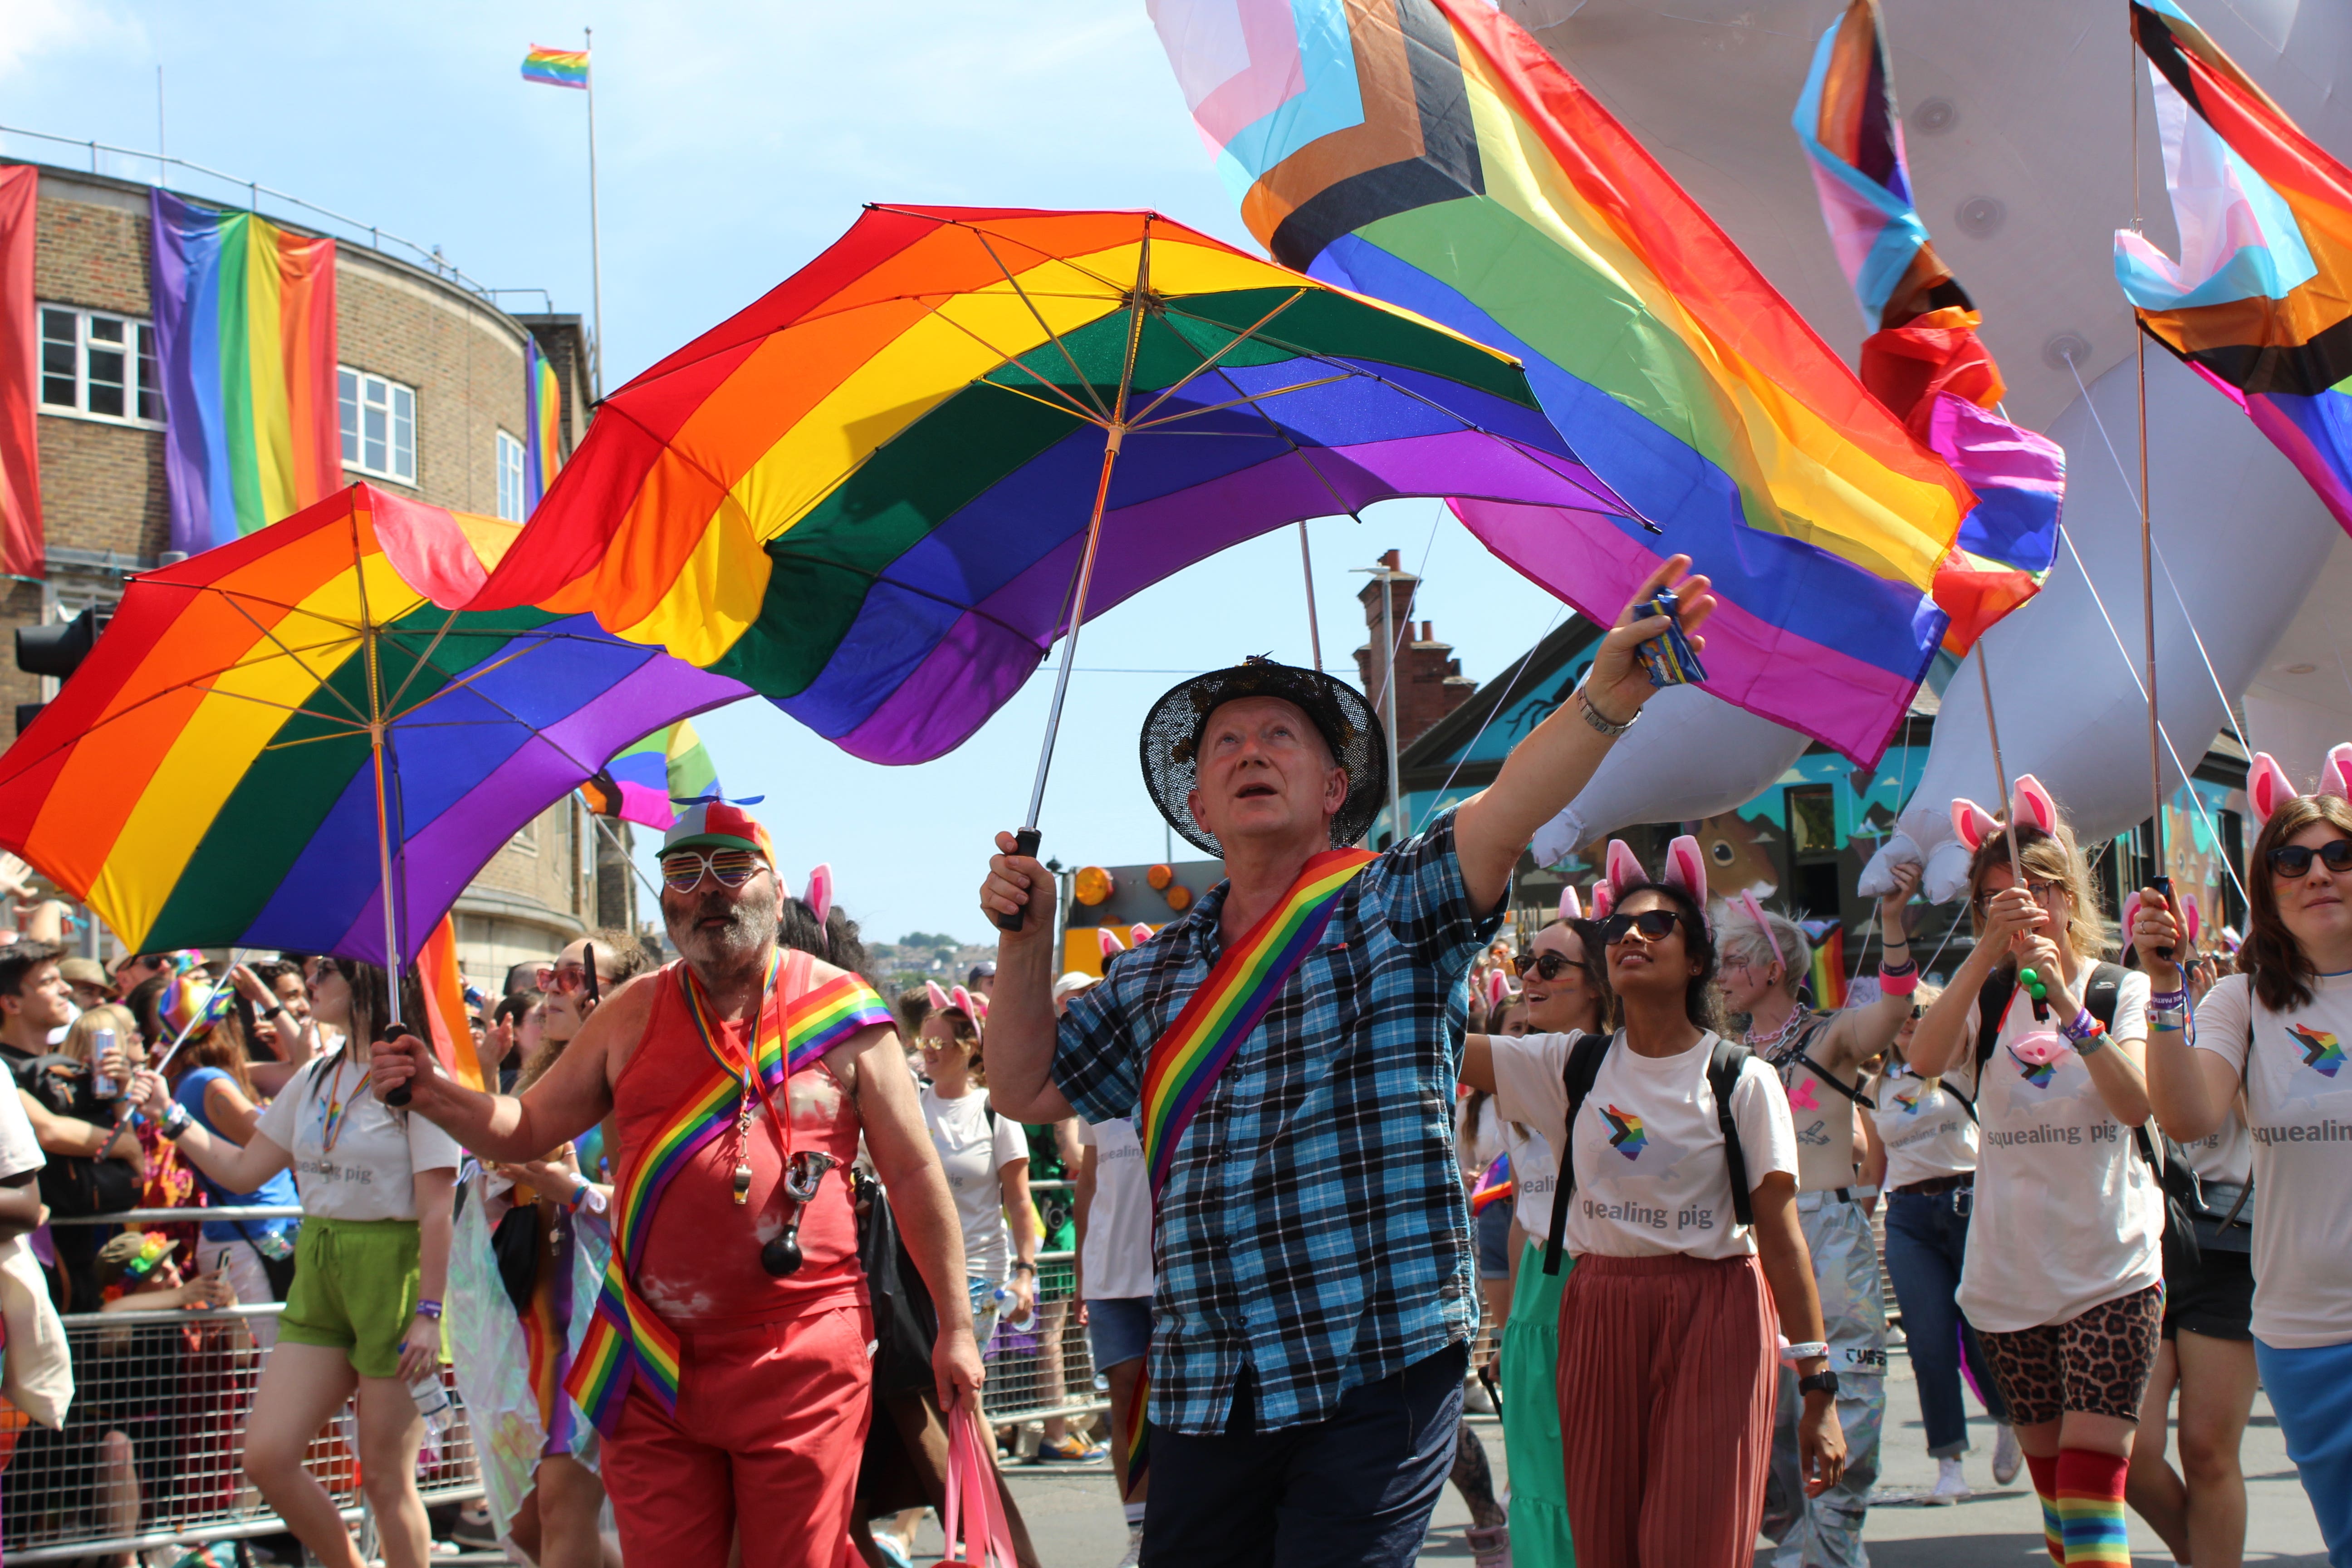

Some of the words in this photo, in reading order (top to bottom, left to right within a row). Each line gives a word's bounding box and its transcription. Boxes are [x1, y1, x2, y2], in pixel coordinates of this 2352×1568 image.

[1986, 1124, 2082, 1148] squealing
[2091, 1120, 2118, 1143] pig
[345, 1165, 372, 1185] pig
[1678, 1205, 1714, 1230] pig
